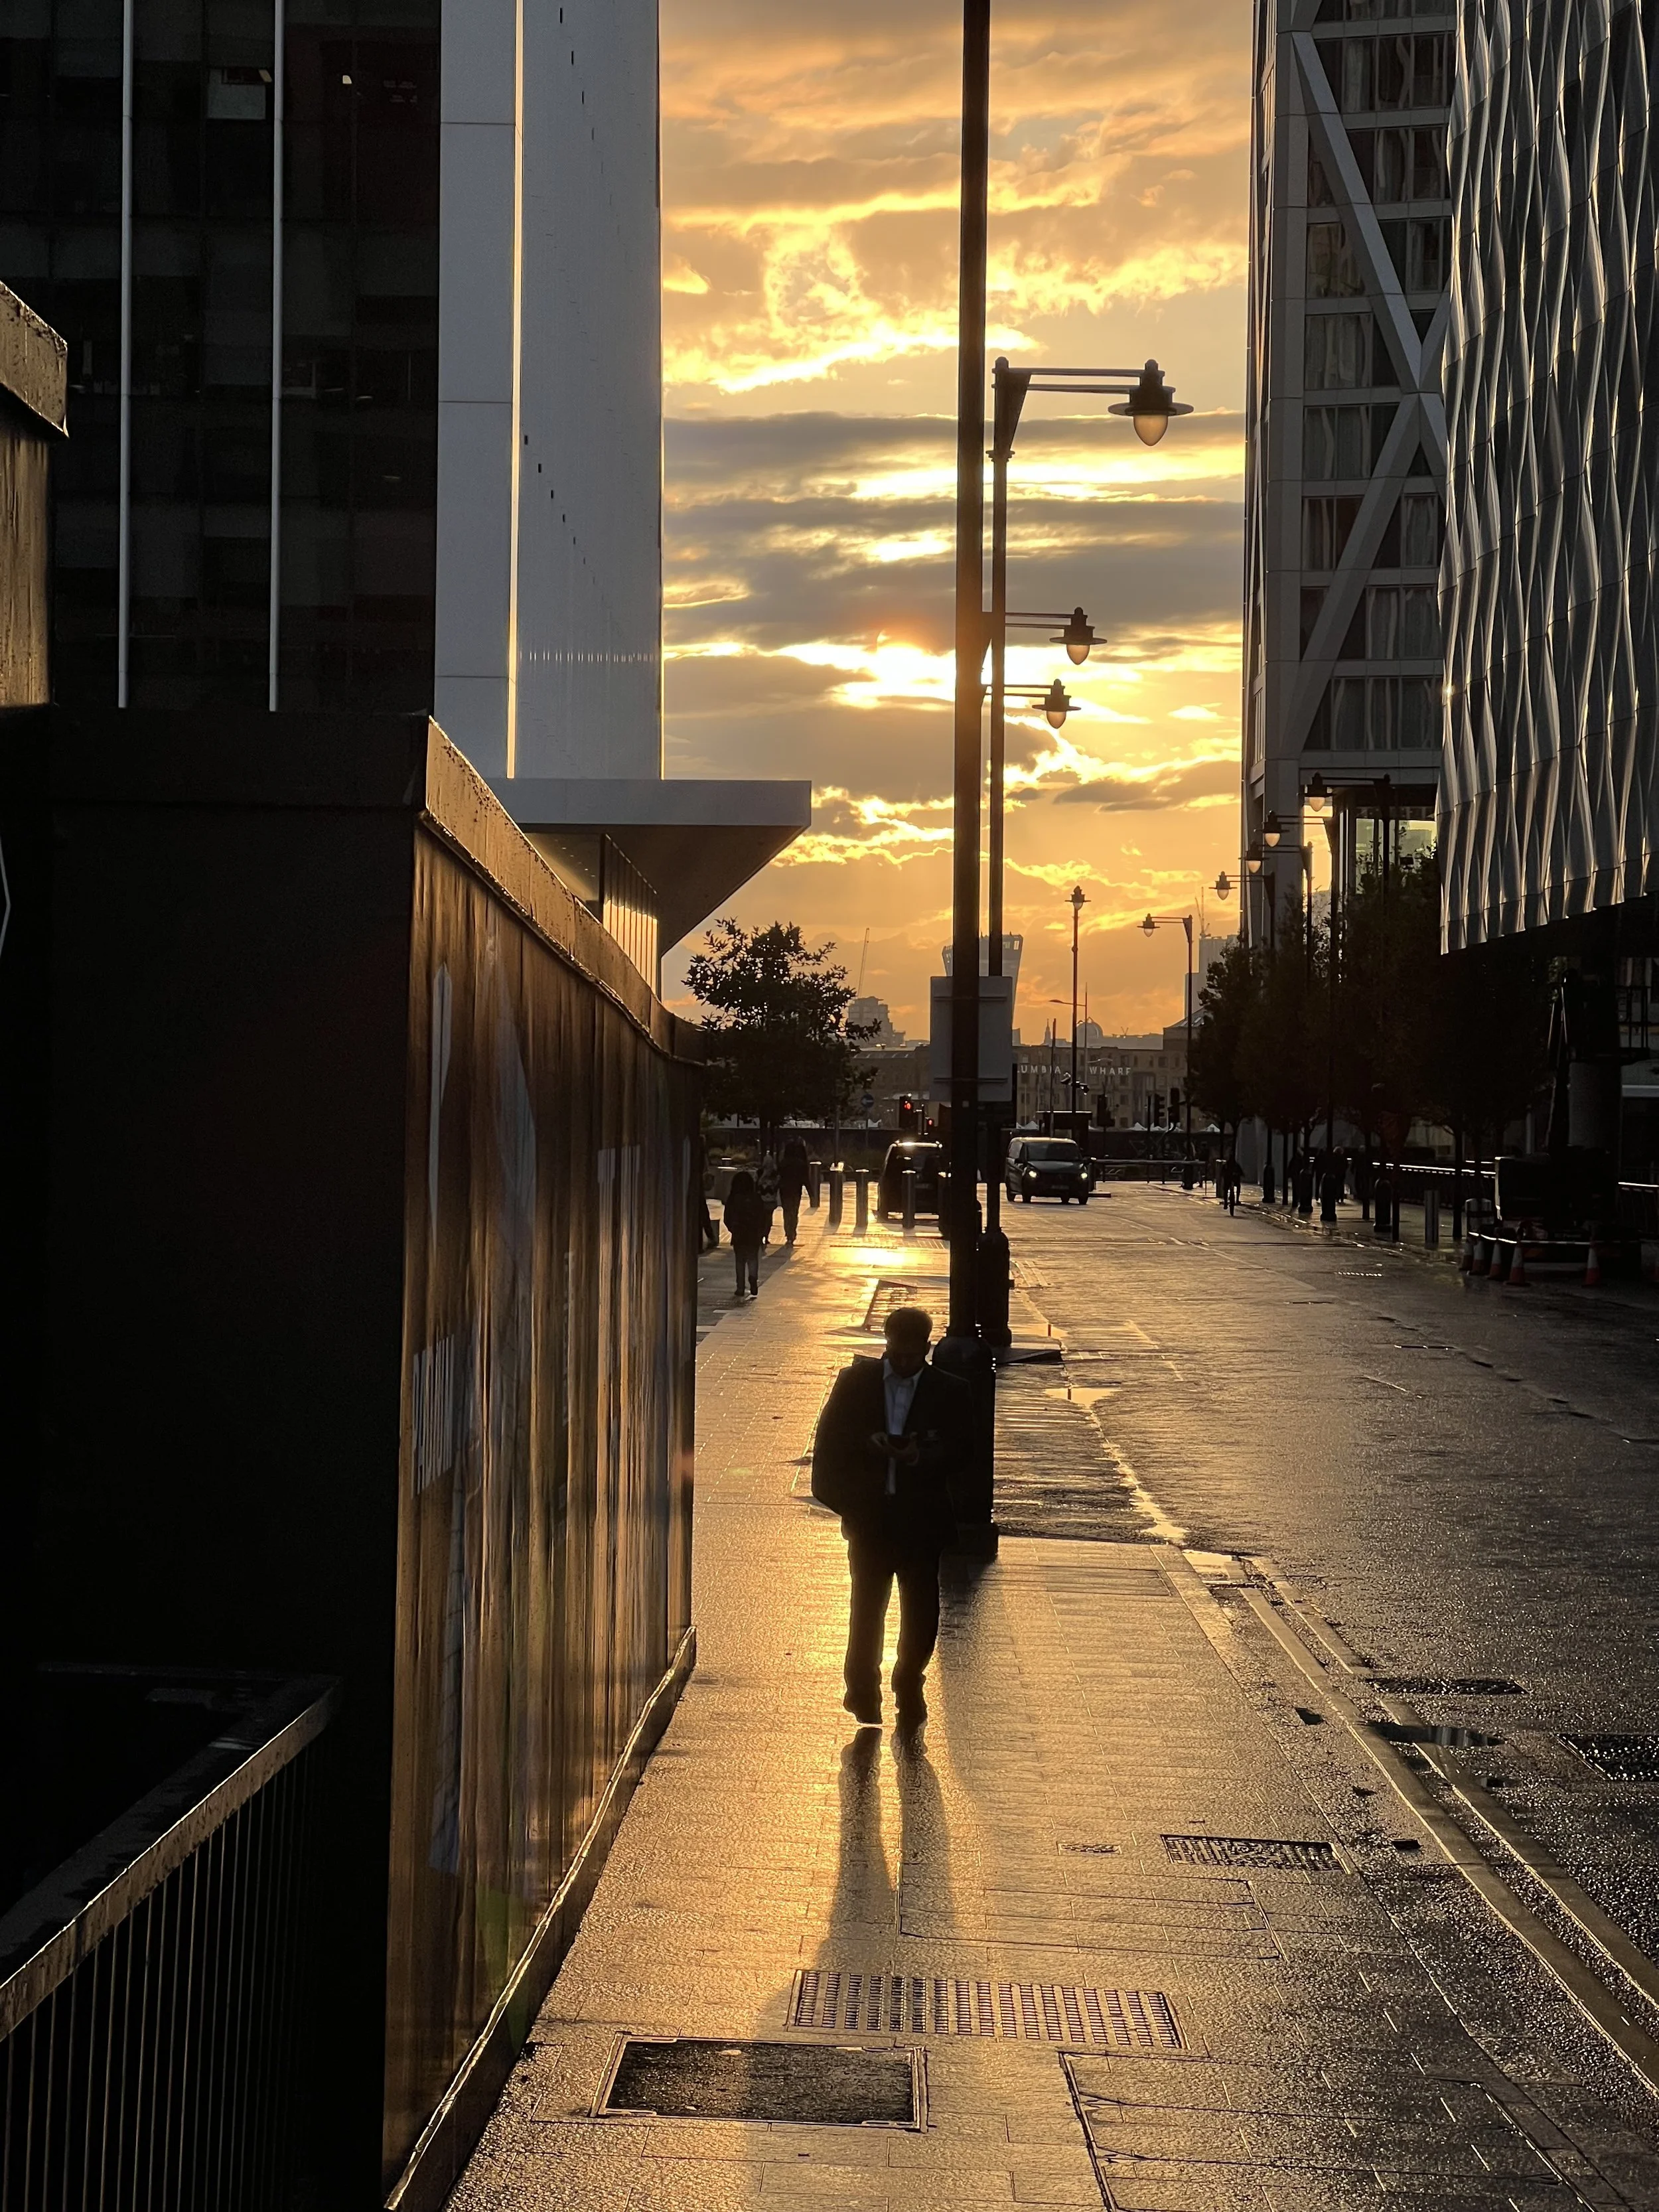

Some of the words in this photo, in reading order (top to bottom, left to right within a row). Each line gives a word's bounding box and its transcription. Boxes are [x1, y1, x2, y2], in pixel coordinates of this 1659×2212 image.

[1017, 1065, 1062, 1074] UMBIA
[1089, 1066, 1132, 1076] WHARF
[411, 1334, 455, 1500] PADIUM
